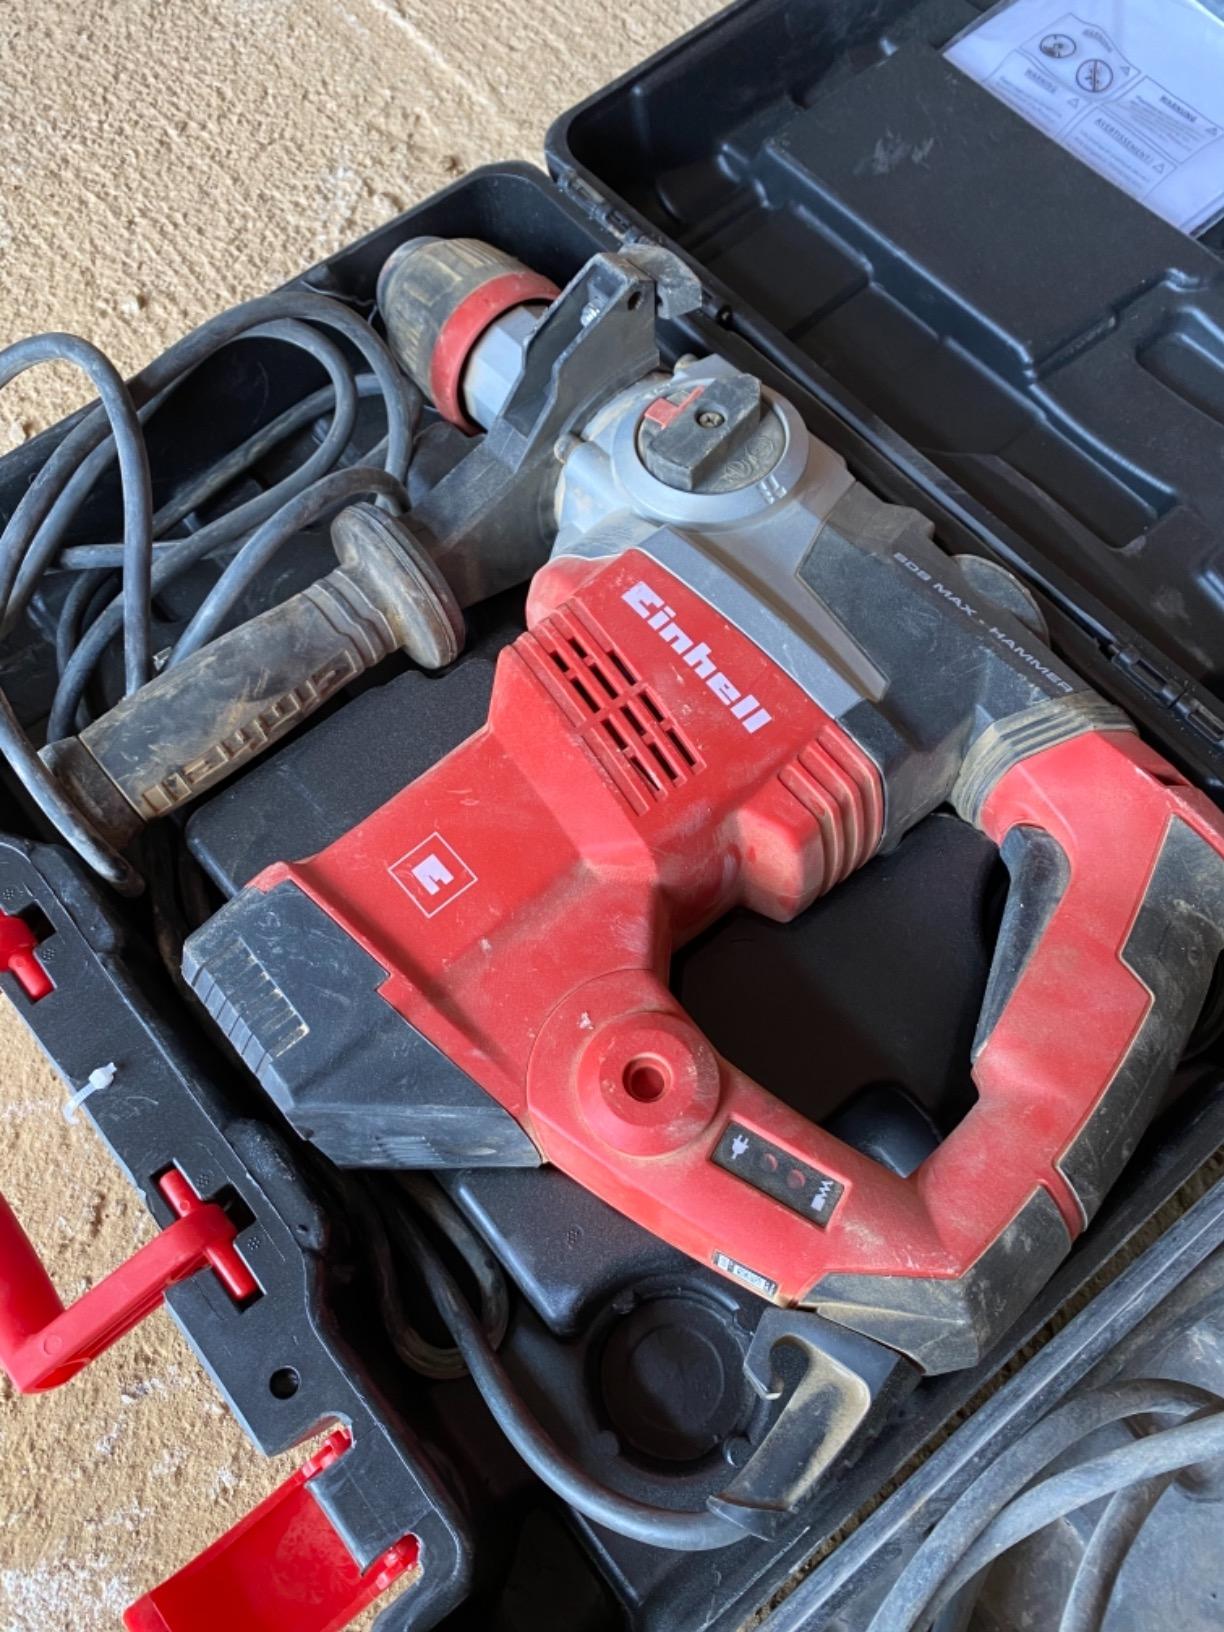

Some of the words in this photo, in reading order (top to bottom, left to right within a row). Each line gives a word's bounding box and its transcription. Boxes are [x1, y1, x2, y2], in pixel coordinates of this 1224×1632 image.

[621, 581, 772, 734] Einhell
[894, 552, 931, 581] SDS
[933, 582, 978, 617] MAX
[989, 627, 1074, 693] HAMMER
